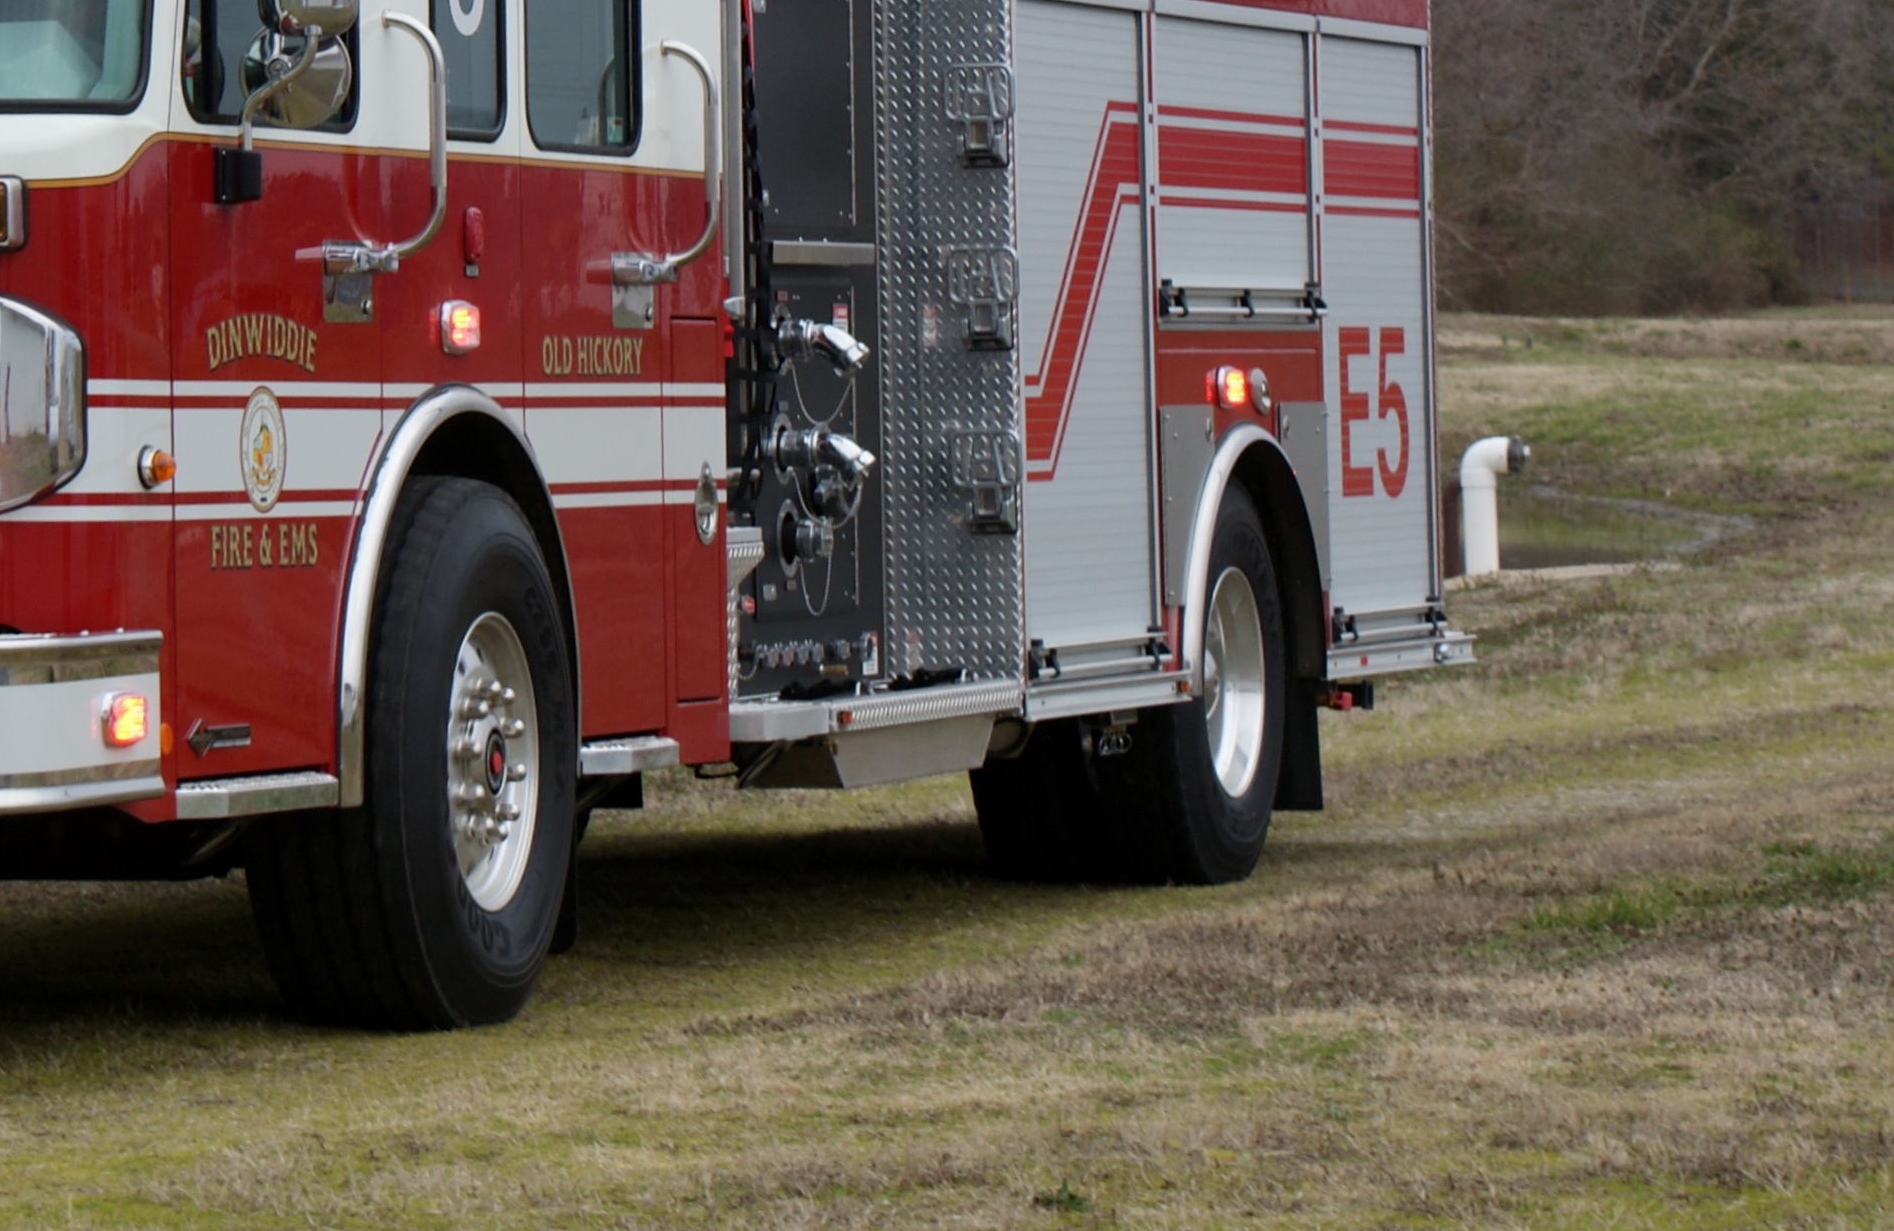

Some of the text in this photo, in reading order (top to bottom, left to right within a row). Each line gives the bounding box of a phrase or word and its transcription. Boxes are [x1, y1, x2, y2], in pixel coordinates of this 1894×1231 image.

[206, 312, 317, 374] DINWIDDIE
[542, 335, 643, 376] OLD HICKORY
[1338, 326, 1410, 499] E5
[210, 522, 318, 569] FIRE & EMS
